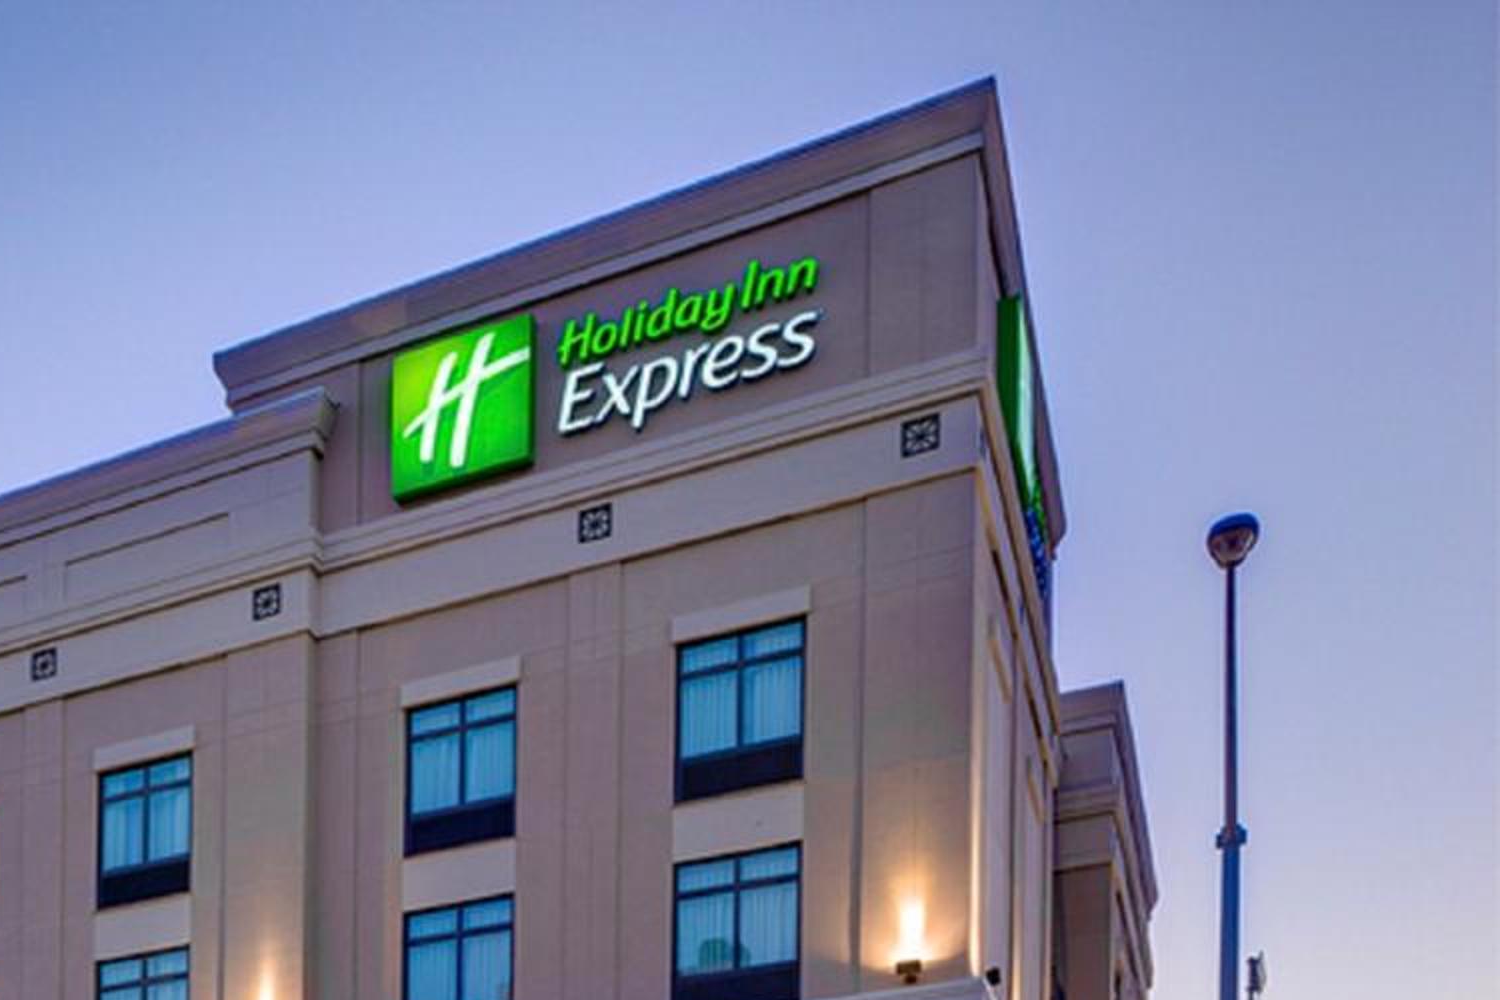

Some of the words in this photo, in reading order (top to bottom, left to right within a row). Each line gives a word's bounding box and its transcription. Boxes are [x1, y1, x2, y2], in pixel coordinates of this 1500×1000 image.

[558, 283, 735, 364] Holiday
[741, 257, 818, 308] Inn
[558, 311, 819, 434] Express
